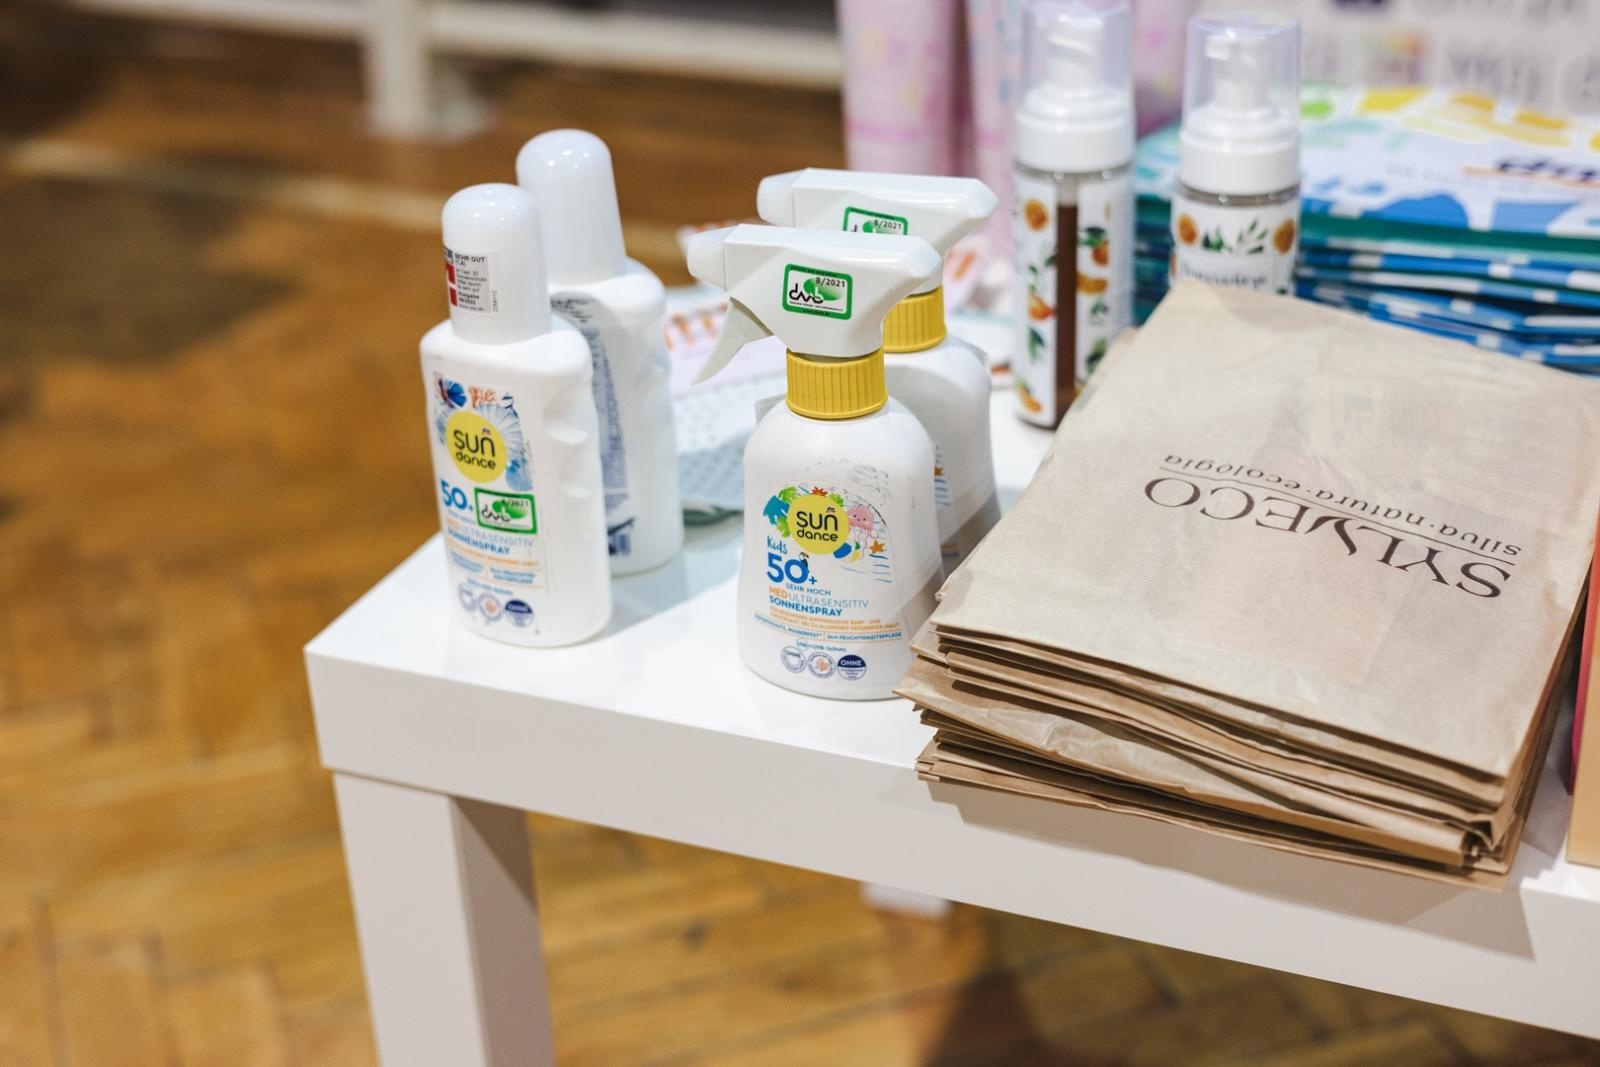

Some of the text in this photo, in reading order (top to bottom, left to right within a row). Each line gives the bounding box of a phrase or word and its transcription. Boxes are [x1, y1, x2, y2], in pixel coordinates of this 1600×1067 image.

[874, 219, 901, 230] 8/2021
[815, 276, 845, 288] 8/2021
[455, 451, 496, 470] dance
[796, 528, 839, 542] dance
[1144, 477, 1512, 599] SYLVECO
[766, 536, 788, 555] Kids
[785, 583, 832, 597] SEHR HOCH
[769, 595, 843, 617] SONNENSPRAY
